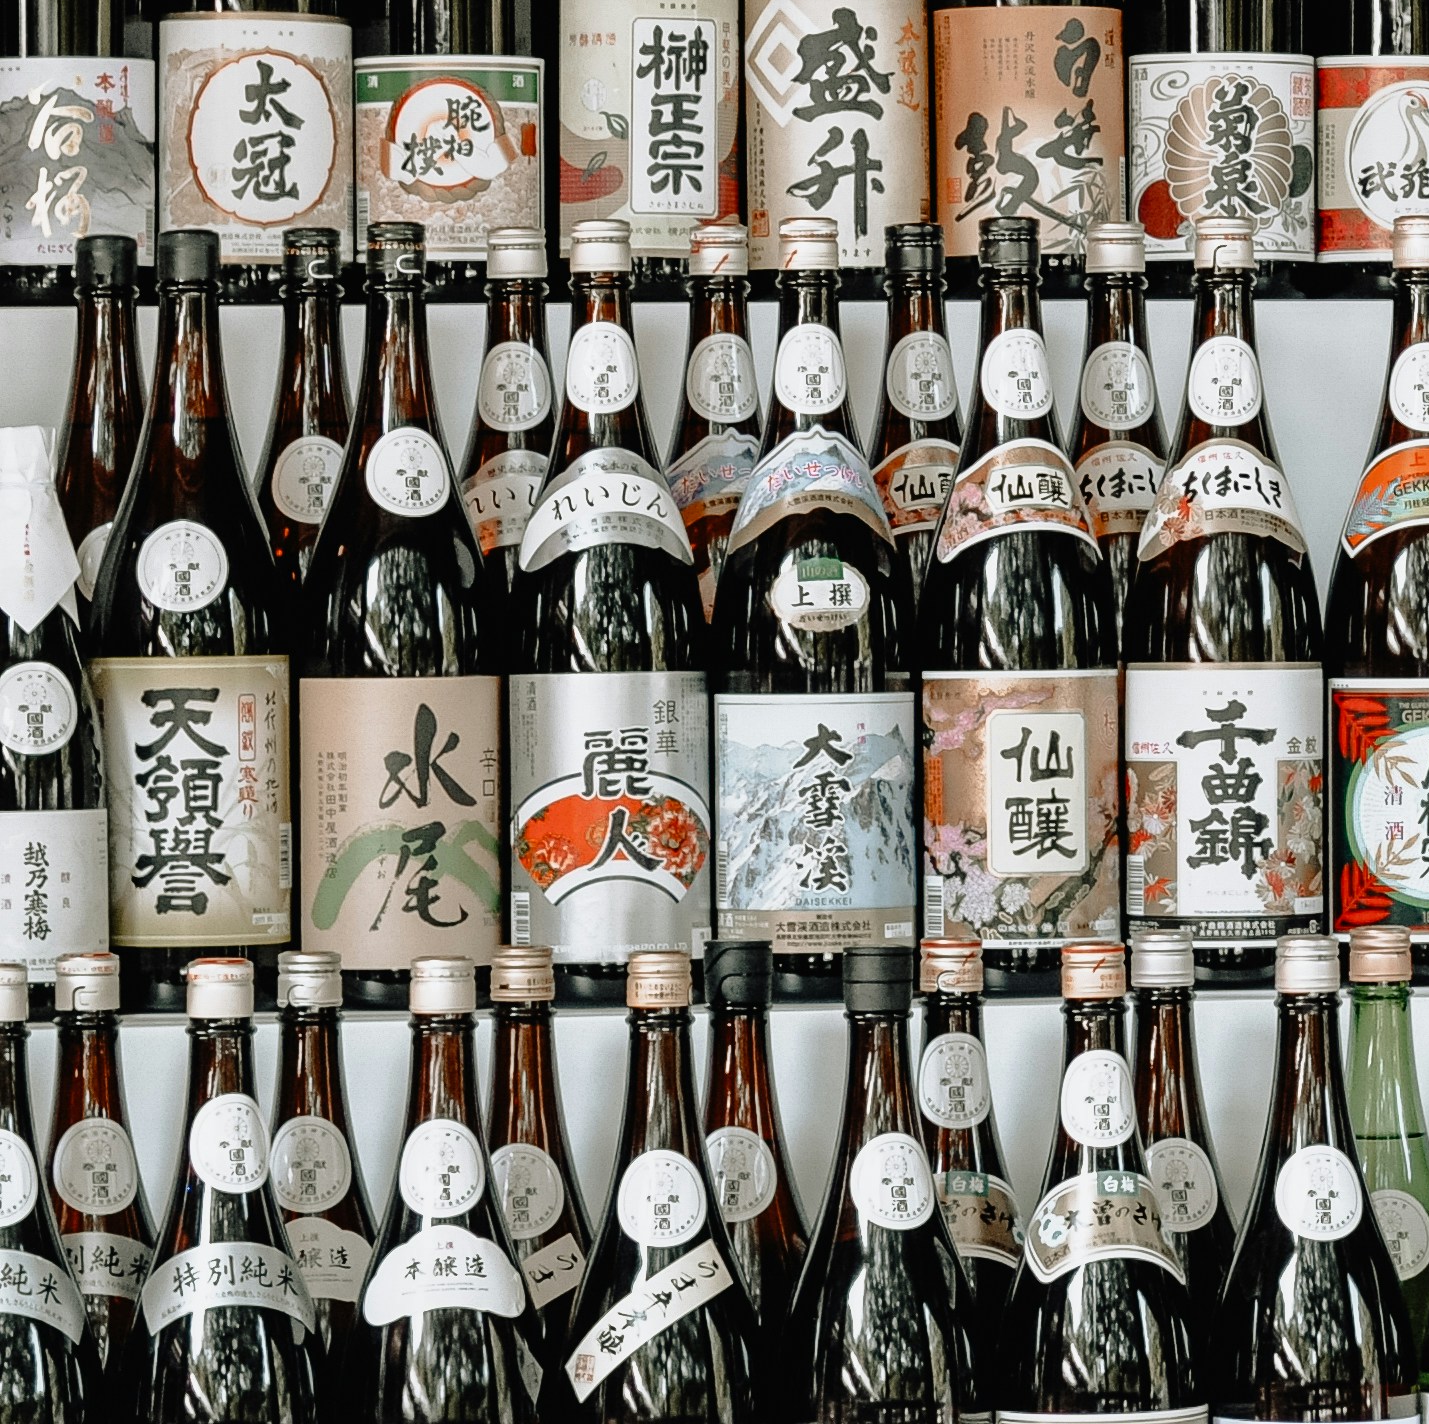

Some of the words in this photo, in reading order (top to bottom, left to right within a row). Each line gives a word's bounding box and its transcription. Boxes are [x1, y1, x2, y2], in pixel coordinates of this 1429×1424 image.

[895, 20, 922, 112] 本醸造
[1035, 17, 1105, 171] 白笹
[231, 61, 304, 202] 太冠
[1203, 79, 1272, 217] 菊泉
[955, 106, 1088, 230] 鼓
[551, 477, 671, 521] れいじん
[1179, 466, 1284, 509] ちくまにしき
[1203, 508, 1239, 522] 日本酒
[791, 583, 853, 609] 上撰
[652, 699, 679, 755] 銀華
[1286, 736, 1320, 755] 金紋
[237, 765, 261, 818] 寒造り
[478, 745, 496, 797] 辛口
[1175, 699, 1277, 878] 千曲錦
[368, 703, 479, 934] 水尾
[580, 725, 665, 873] 麗人
[1383, 784, 1404, 843] 清酒
[22, 840, 52, 942] 越乃寒梅
[796, 896, 853, 907] DAISEKKEI
[1101, 1175, 1136, 1195] 白梅
[172, 1255, 299, 1298] 特別純米
[403, 1256, 488, 1282] 本醸造
